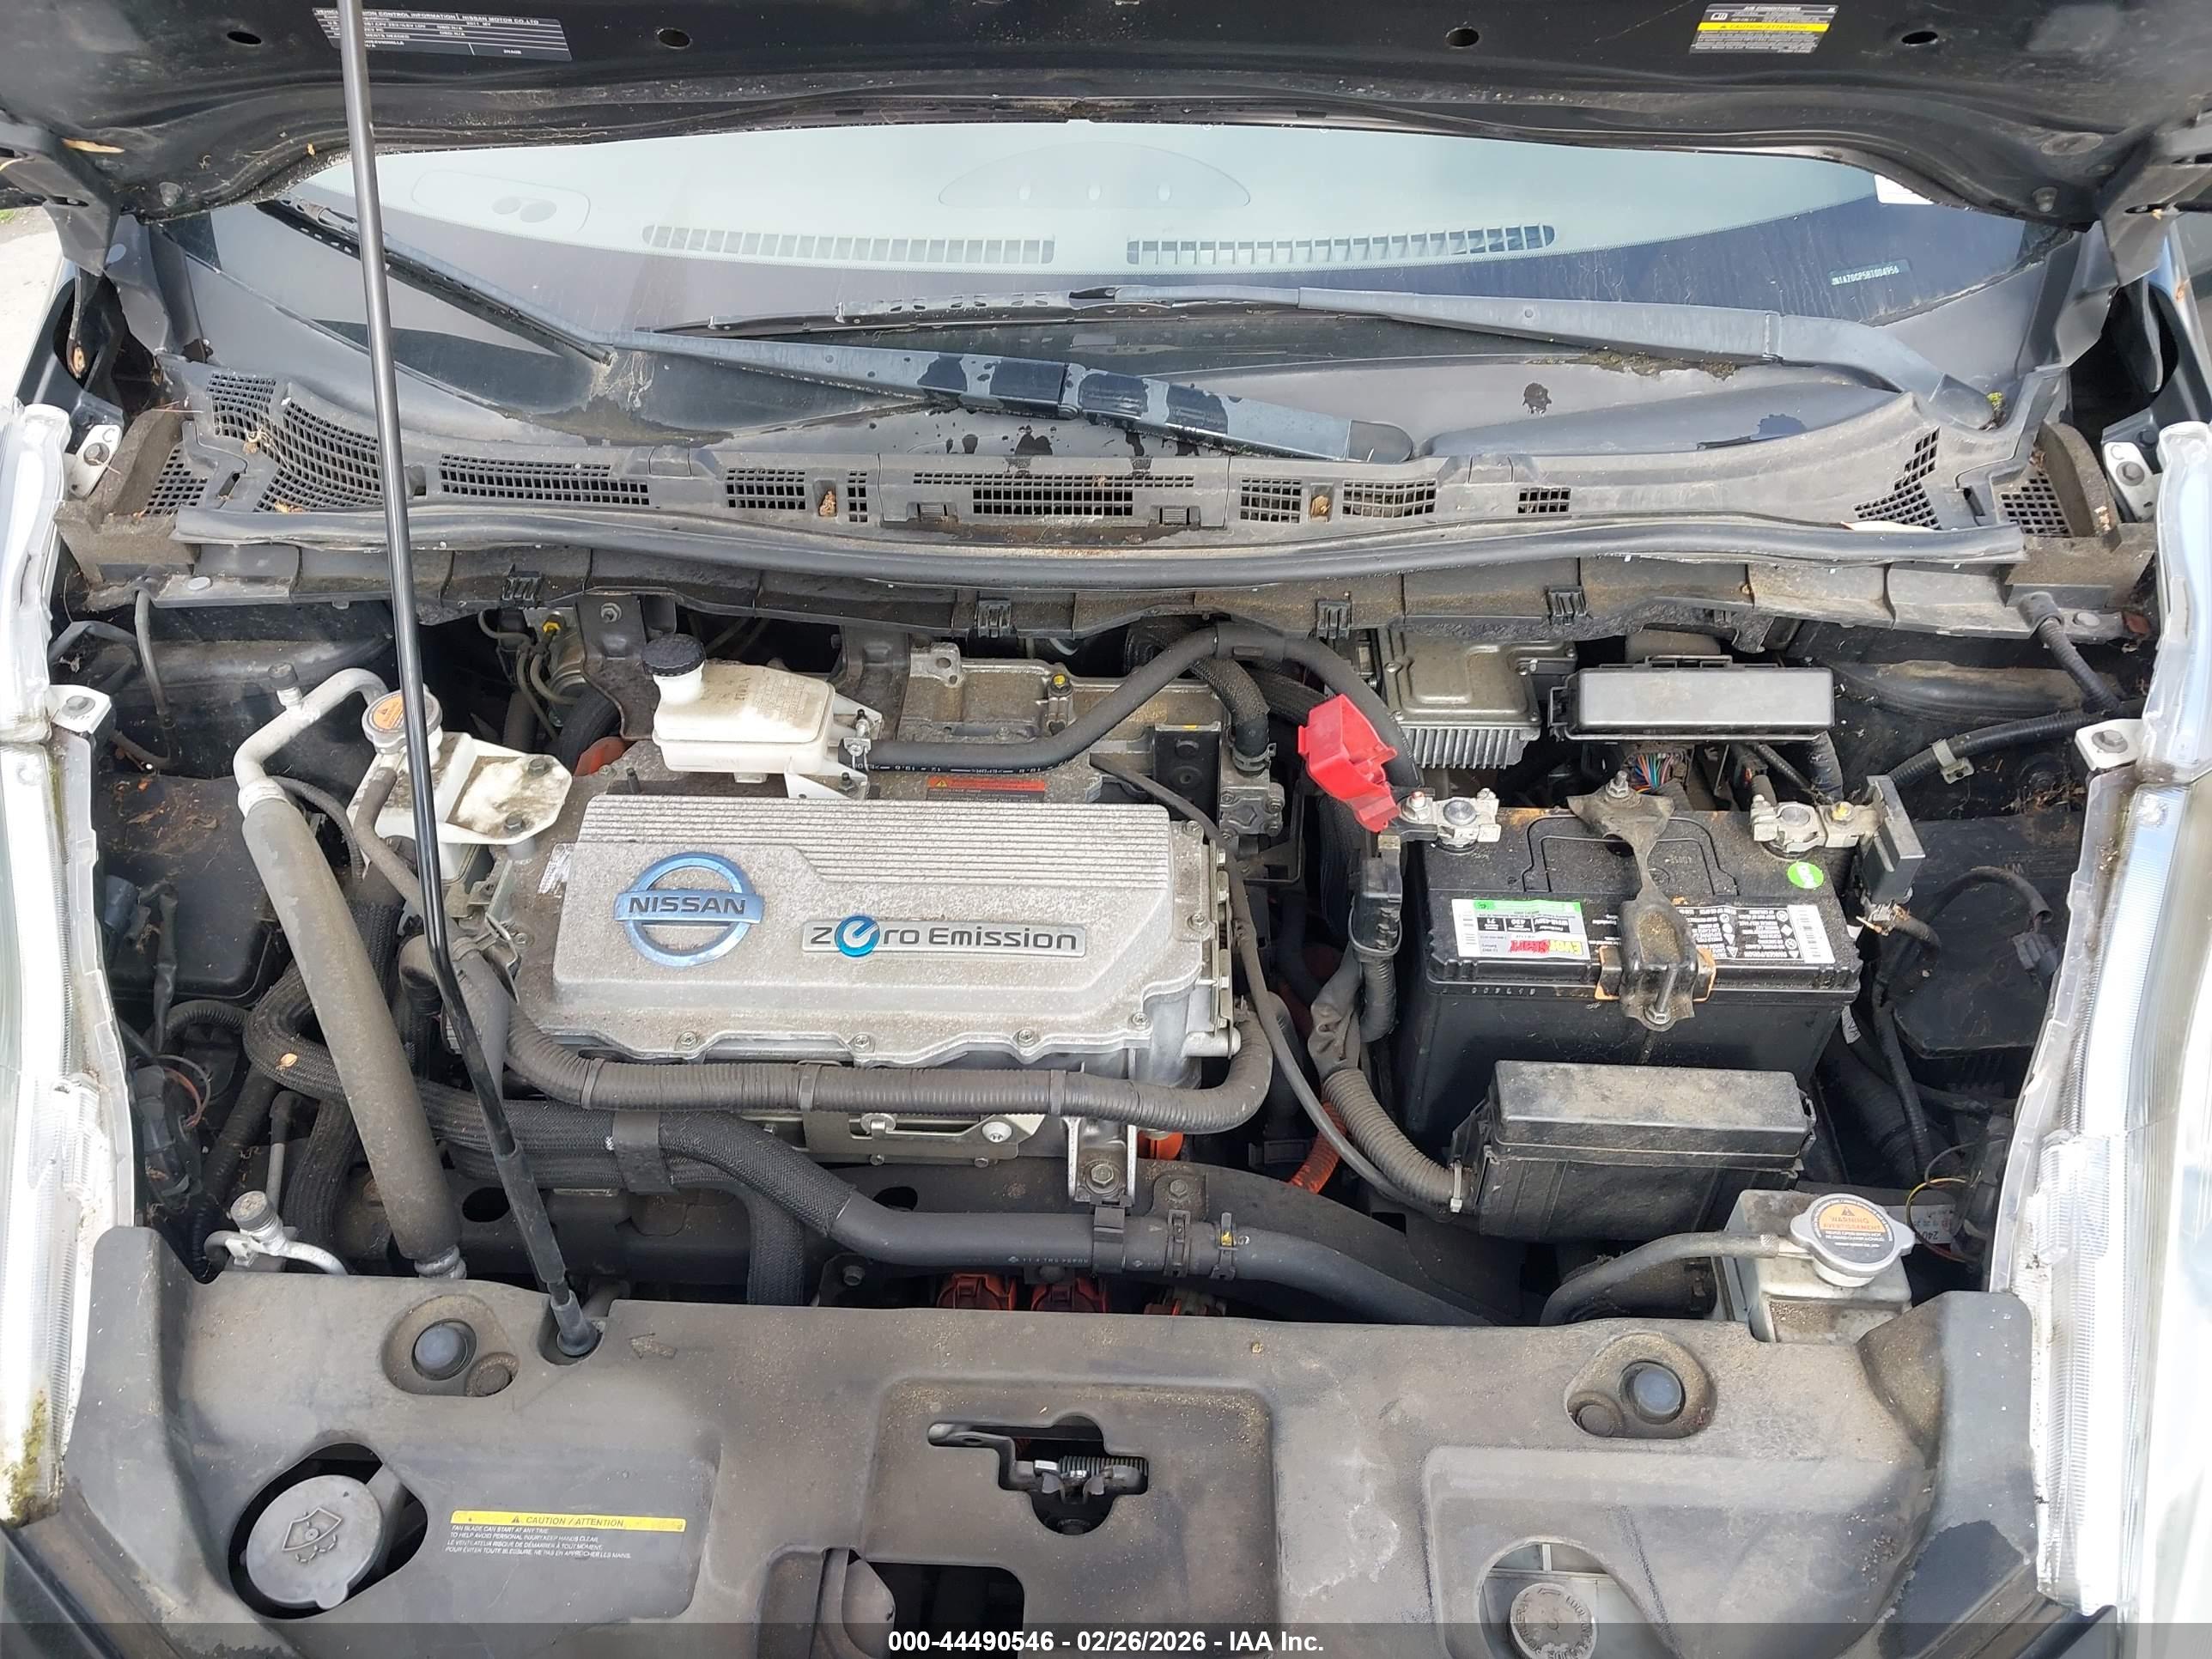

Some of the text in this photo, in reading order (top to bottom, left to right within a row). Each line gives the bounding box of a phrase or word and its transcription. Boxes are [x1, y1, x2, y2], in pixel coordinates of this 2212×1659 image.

[629, 896, 746, 916] NISSAN
[929, 926, 1077, 951] Emission
[526, 1516, 567, 1525] CAUTION
[574, 1517, 624, 1527] ATTENTION
